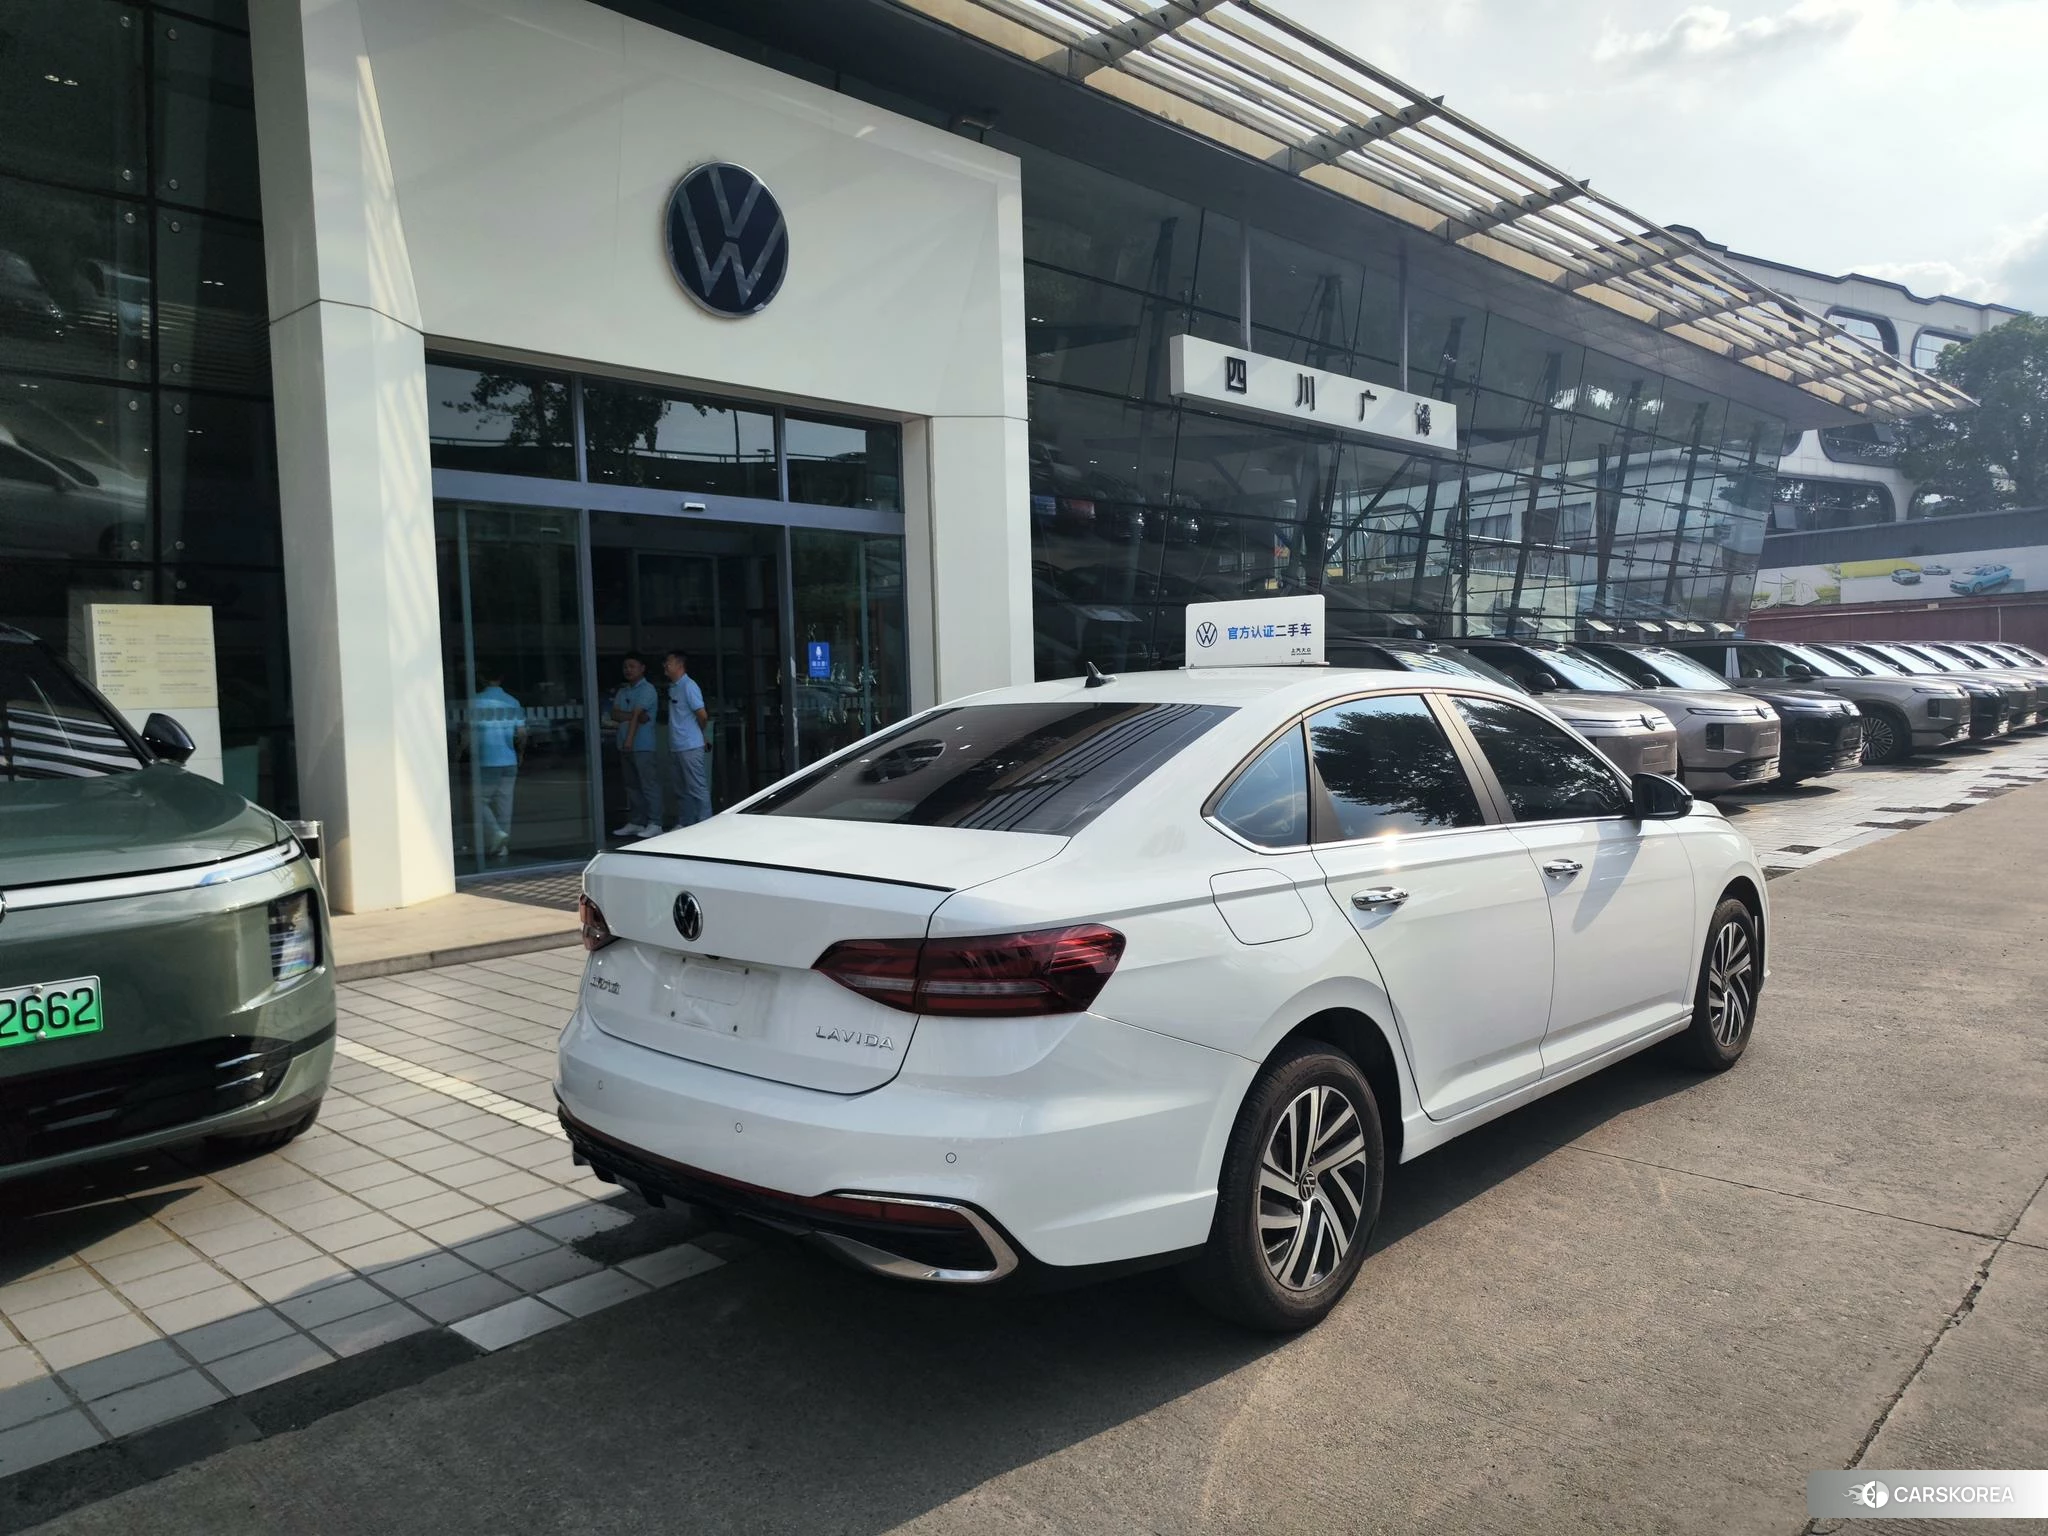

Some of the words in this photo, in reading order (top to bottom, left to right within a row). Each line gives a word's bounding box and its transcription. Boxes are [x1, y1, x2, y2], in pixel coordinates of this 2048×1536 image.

[1227, 623, 1312, 640] 官方认证二手车
[0, 986, 96, 1038] 2662
[815, 1026, 894, 1051] LAVIDA
